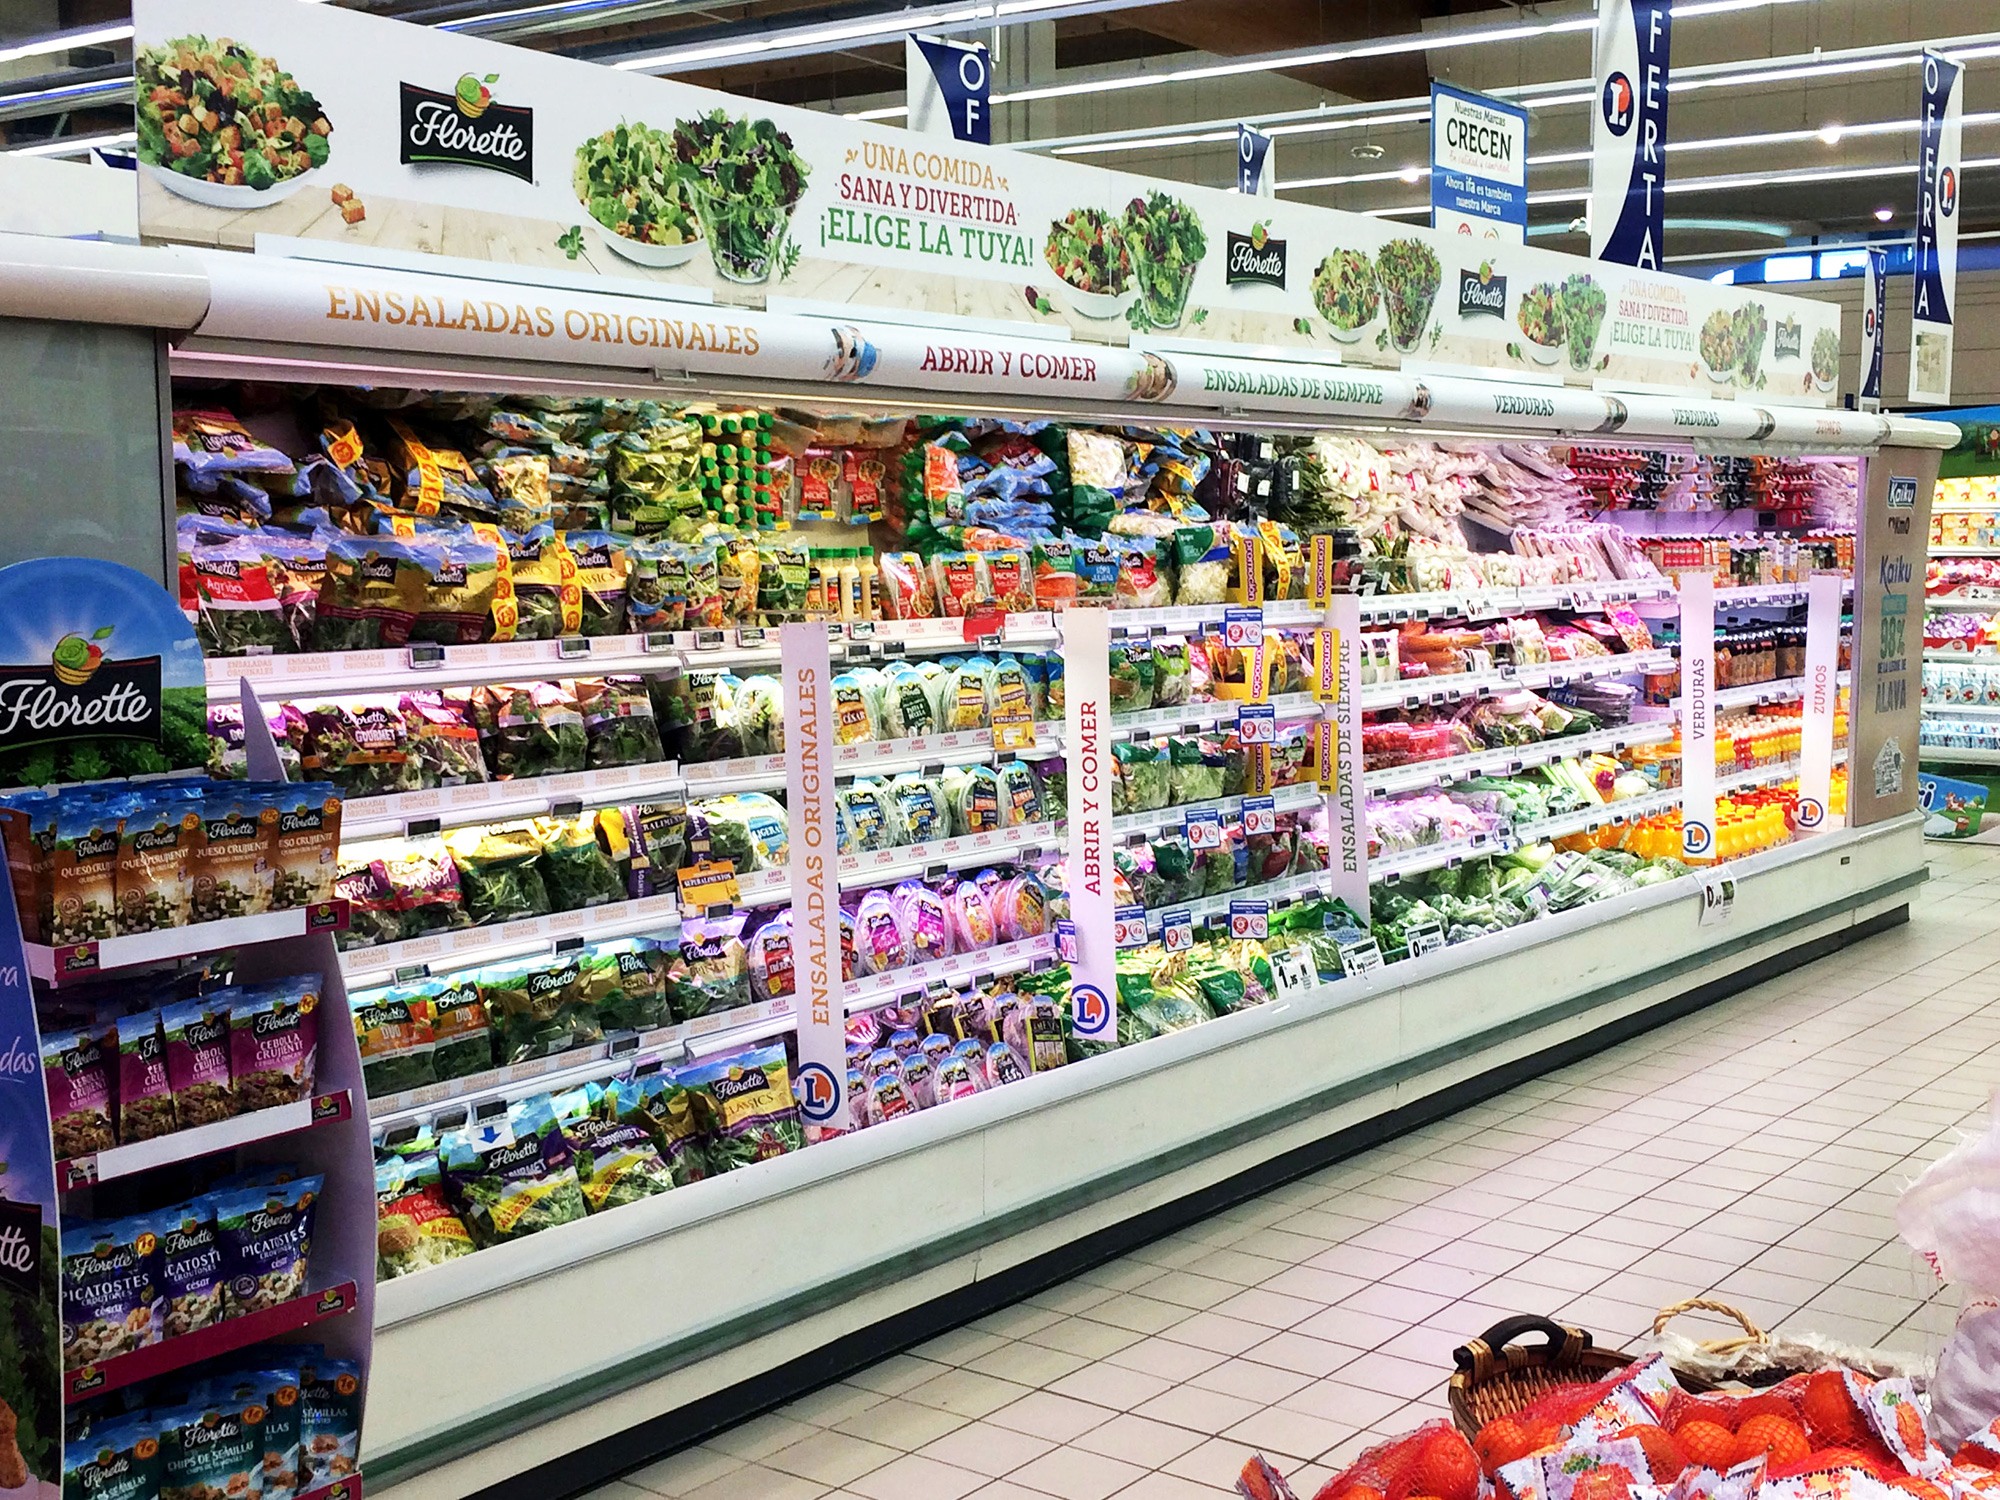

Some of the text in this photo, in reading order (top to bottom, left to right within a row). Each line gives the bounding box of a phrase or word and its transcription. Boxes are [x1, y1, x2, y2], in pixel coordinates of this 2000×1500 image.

[1454, 101, 1506, 126] Nuestras Marcas
[411, 101, 526, 161] Florette
[1446, 118, 1512, 161] CRECEN
[1637, 9, 1662, 270] FERTA
[863, 142, 995, 188] UNA COMIDA
[840, 173, 1018, 226] SANA Y DIVERTIDA
[1445, 175, 1464, 191] Ahora
[1476, 185, 1484, 196] es
[1485, 186, 1512, 202] también
[1917, 58, 1939, 316] OFERTA
[1456, 196, 1501, 216] nuestra Marca
[819, 207, 1034, 267] ¡ELIGE LA TUYA!
[1230, 243, 1283, 277] Florette
[1463, 278, 1503, 308] Florette
[1628, 279, 1681, 301] UNA COMIDA
[325, 286, 760, 356] ENSALADAS ORIGINALES
[1619, 300, 1689, 326] SANA Y DIVERTIDA
[1872, 253, 1885, 396] OFERTA
[1610, 322, 1694, 351] ¡ELIGE LA TUYA!
[921, 345, 1098, 382] ABRIR Y COMER
[1204, 368, 1383, 405] ENSALADAS DE SIEMPRE
[1493, 394, 1555, 417] VERDURAS
[1673, 409, 1720, 428] VERDURAS
[1815, 419, 1842, 436] ZUMOS
[1890, 483, 1914, 503] Kaiku
[1246, 539, 1256, 602] promoción
[1316, 538, 1325, 598] promoción
[1880, 555, 1912, 584] Kaiku
[1880, 617, 1906, 659] 98%
[1322, 631, 1332, 690] promoción
[1692, 658, 1705, 740] VERDURAS
[1814, 664, 1827, 714] ZUMOS
[0, 679, 151, 735] Florette
[355, 729, 396, 742] GOURMET
[1322, 723, 1331, 780] promoción
[1337, 640, 1358, 873] ENSALADAS DE SIEMPRE
[1080, 701, 1101, 896] ABRIR Y COMER
[210, 822, 254, 839] Florette
[282, 812, 321, 830] Florette
[84, 838, 116, 857] Florette
[136, 830, 176, 848] Florette
[227, 841, 269, 855] CRUJIENTE
[297, 832, 333, 846] CRUJIENTE
[798, 668, 829, 1027] ENSALADAS ORIGINALES
[61, 865, 92, 877] QUESO
[532, 971, 578, 994] Florette
[439, 990, 478, 1008] Florette
[257, 1012, 300, 1032] Florette
[366, 1006, 408, 1028] Florette
[455, 1008, 472, 1022] DUO
[260, 1033, 299, 1050] CEBOLLA
[381, 1026, 401, 1039] DUO
[66, 1051, 101, 1071] Florette
[256, 1042, 304, 1060] CRUJIENTE
[715, 1074, 764, 1099] Florette
[727, 1095, 774, 1117] CLASSICS
[596, 1128, 640, 1149] GOURMET
[490, 1141, 538, 1169] Florette
[252, 1212, 293, 1233] Florette
[165, 1230, 214, 1254] Florette
[242, 1227, 306, 1257] PICATOSTES
[74, 1252, 132, 1280] Florette
[271, 1256, 288, 1269] césar
[62, 1273, 149, 1301] PICATOSTES
[186, 1275, 210, 1291] césar
[302, 1407, 348, 1419] SEMILLAS
[185, 1423, 239, 1449] Florette
[84, 1457, 130, 1488] Florette
[168, 1457, 197, 1472] CHIPS
[198, 1453, 210, 1466] DE
